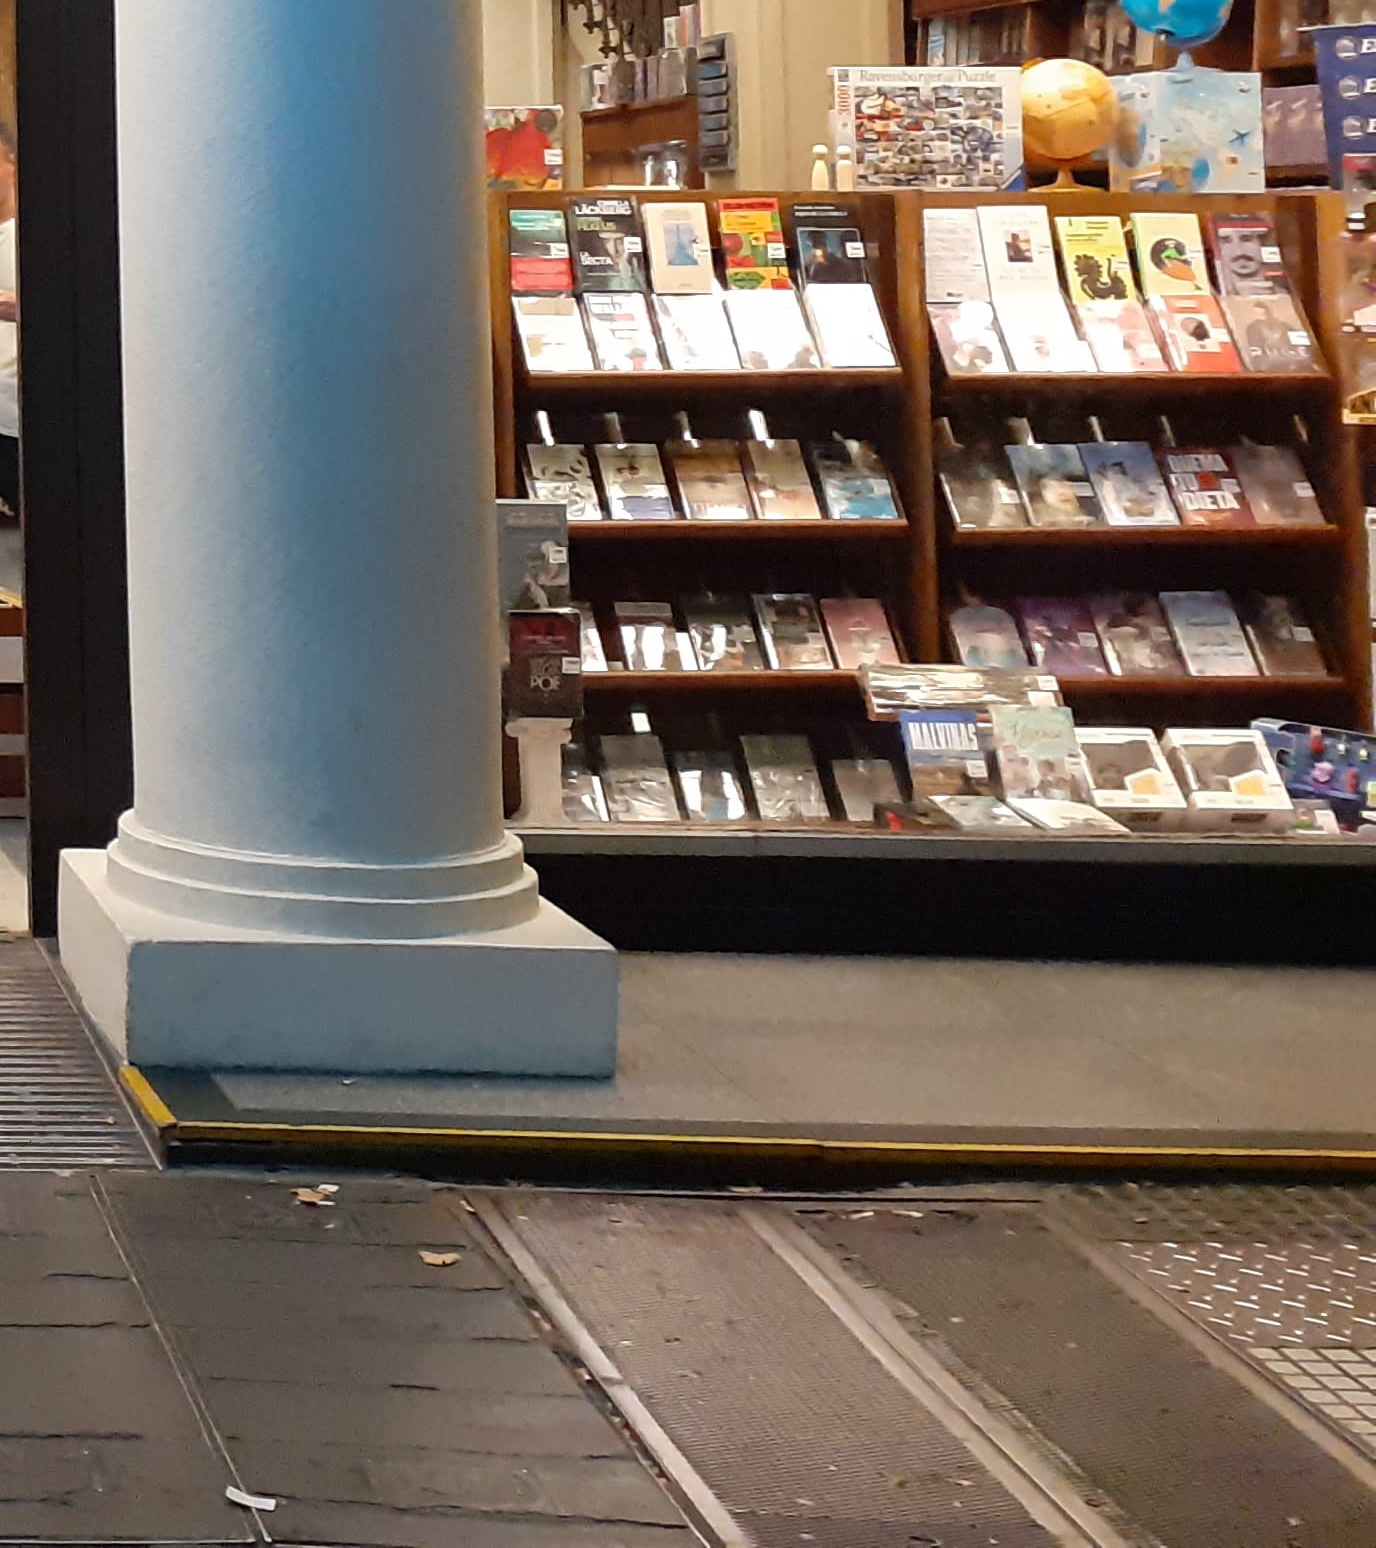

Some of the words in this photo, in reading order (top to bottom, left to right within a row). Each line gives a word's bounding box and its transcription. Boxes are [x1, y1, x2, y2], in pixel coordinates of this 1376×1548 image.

[860, 70, 943, 85] Ravensburger
[957, 70, 996, 82] Puzzle
[1178, 492, 1241, 510] DIETA
[908, 722, 978, 750] MALVINAS
